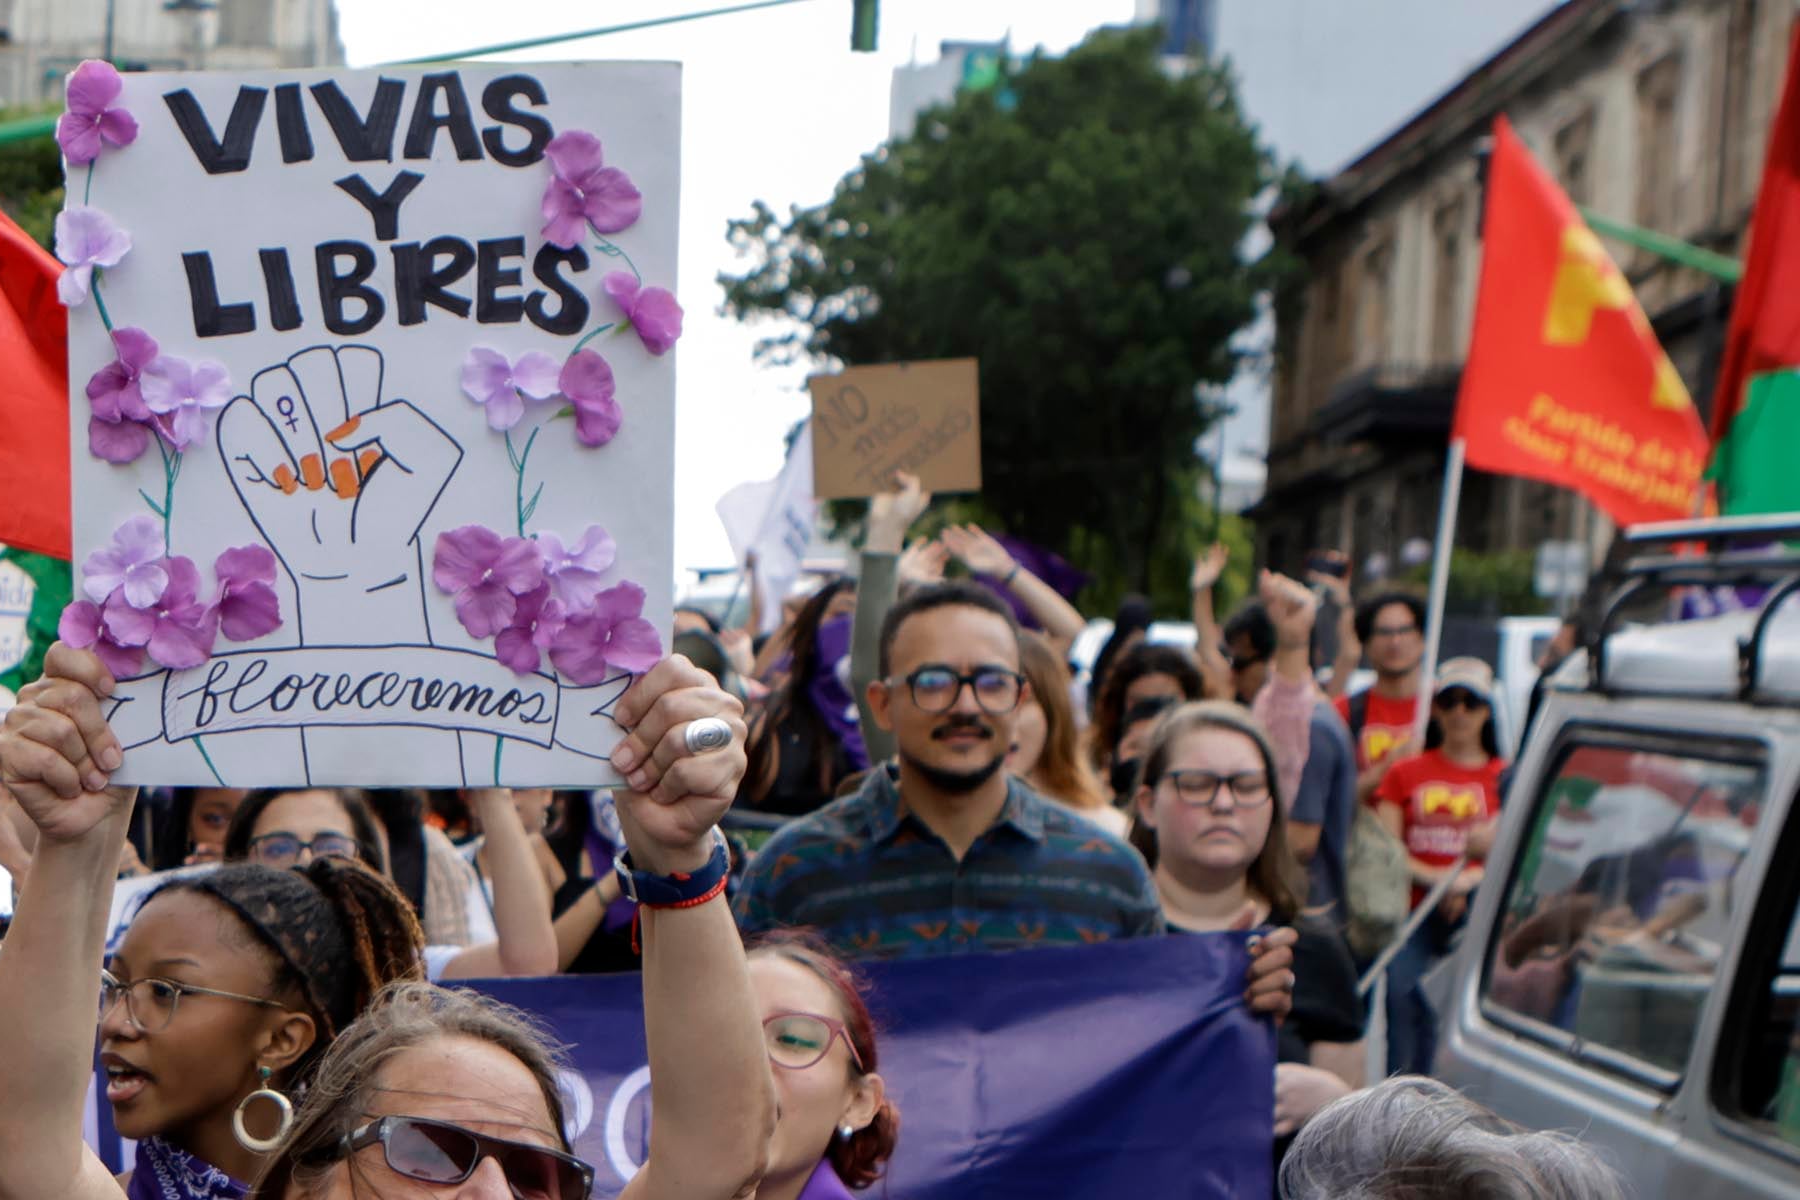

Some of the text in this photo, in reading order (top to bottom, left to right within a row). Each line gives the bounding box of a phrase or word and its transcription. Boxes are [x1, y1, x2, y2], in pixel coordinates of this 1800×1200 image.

[163, 71, 554, 174] VIVAS
[333, 170, 425, 241] Y
[182, 236, 590, 338] LIBRES
[178, 659, 554, 728] floreceremos
